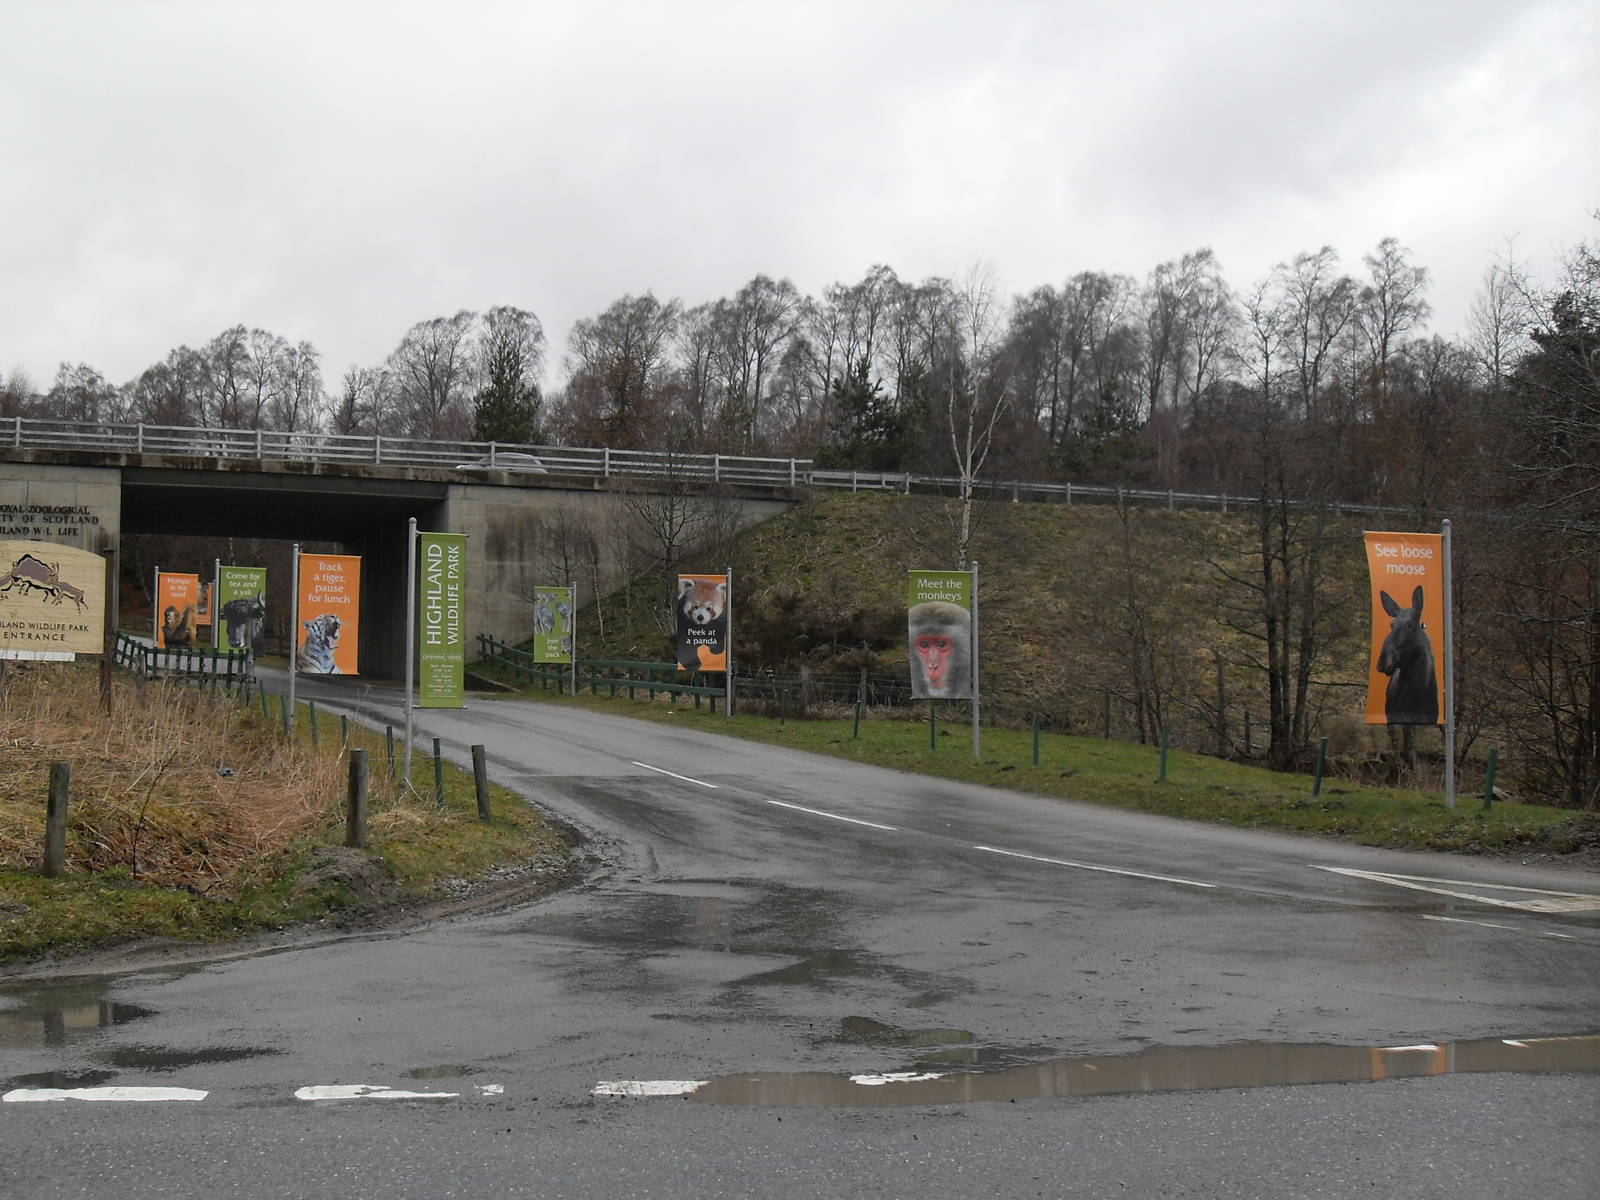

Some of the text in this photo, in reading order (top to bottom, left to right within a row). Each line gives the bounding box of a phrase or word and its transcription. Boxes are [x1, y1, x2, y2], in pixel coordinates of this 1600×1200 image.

[0, 504, 90, 515] OYAL ZOOLOGICAL
[22, 514, 36, 523] OF
[43, 515, 99, 525] SCOTLAND
[1374, 543, 1433, 559] See loose
[319, 561, 343, 571] Track
[1386, 563, 1425, 575] moose
[226, 571, 260, 581] Come for
[313, 574, 320, 582] a
[917, 579, 963, 589] Meet the
[239, 589, 252, 597] yak
[315, 585, 344, 594] pause
[426, 544, 442, 645] HIGHLAND
[308, 592, 351, 604] for lunch
[447, 545, 459, 645] WILDLIFE PARK
[917, 590, 963, 603] monkeys
[28, 622, 66, 631] WILDLIFE
[68, 624, 90, 632] PARK
[687, 628, 707, 636] Peek
[3, 631, 66, 642] ENTRANCE
[693, 637, 718, 646] panda
